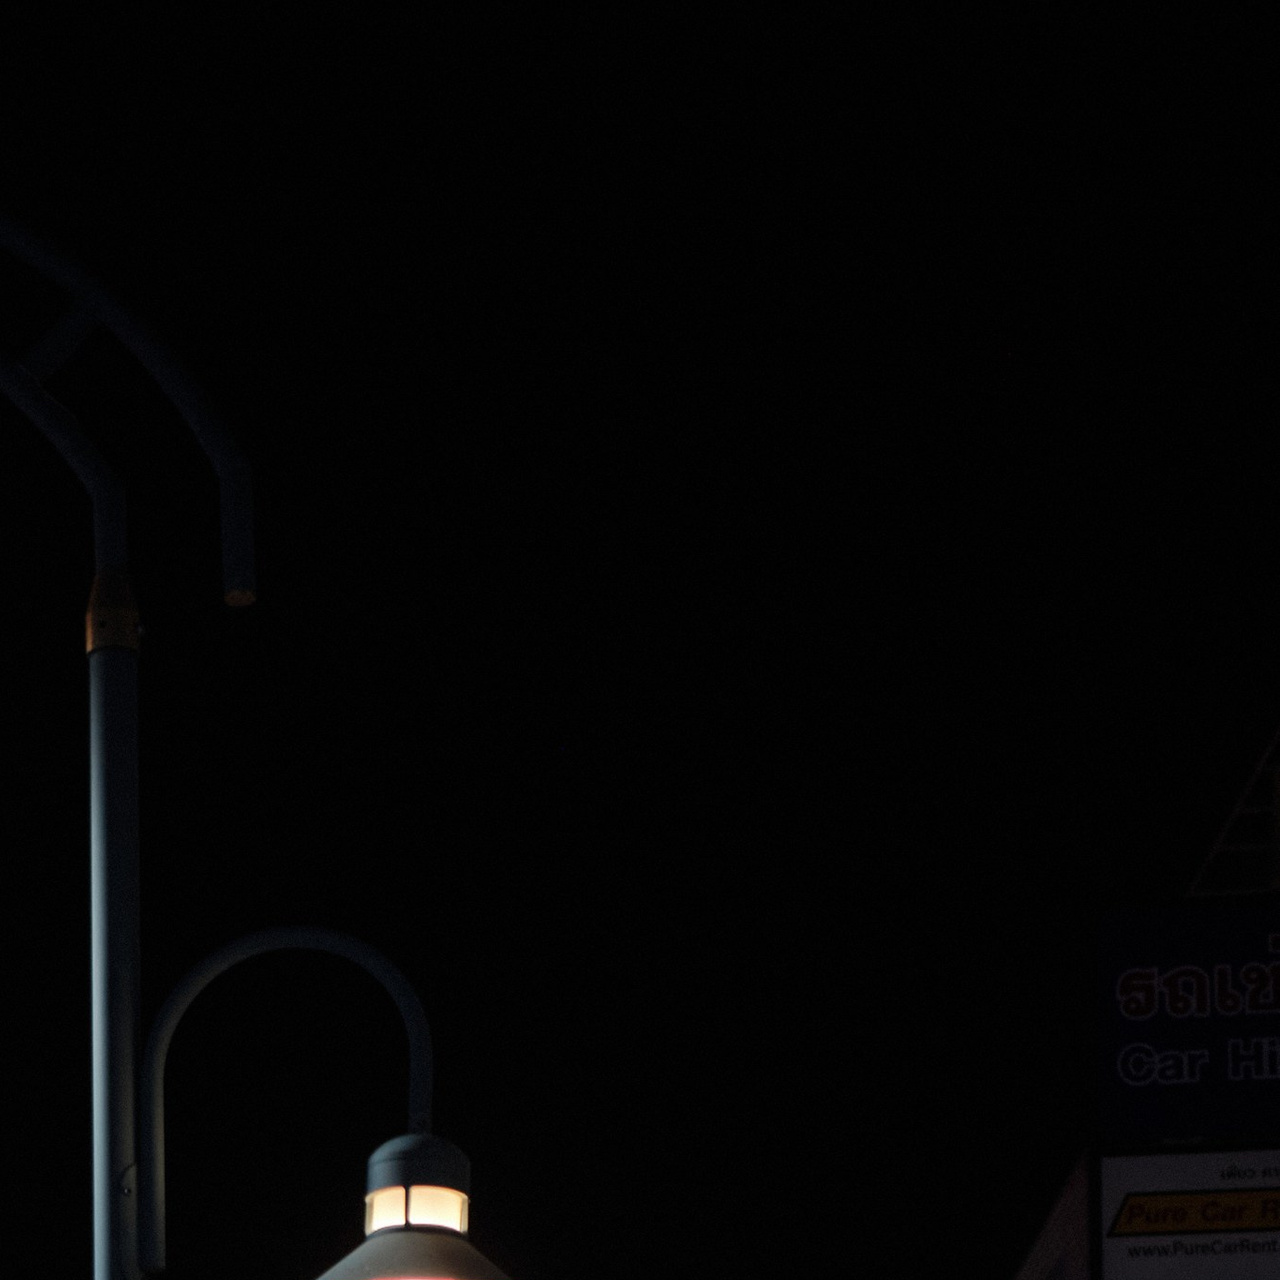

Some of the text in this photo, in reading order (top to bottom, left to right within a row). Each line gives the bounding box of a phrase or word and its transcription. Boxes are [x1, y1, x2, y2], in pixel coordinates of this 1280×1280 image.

[1117, 1042, 1209, 1086] Car
[1125, 1202, 1188, 1225] Pure
[1201, 1200, 1247, 1222] Car
